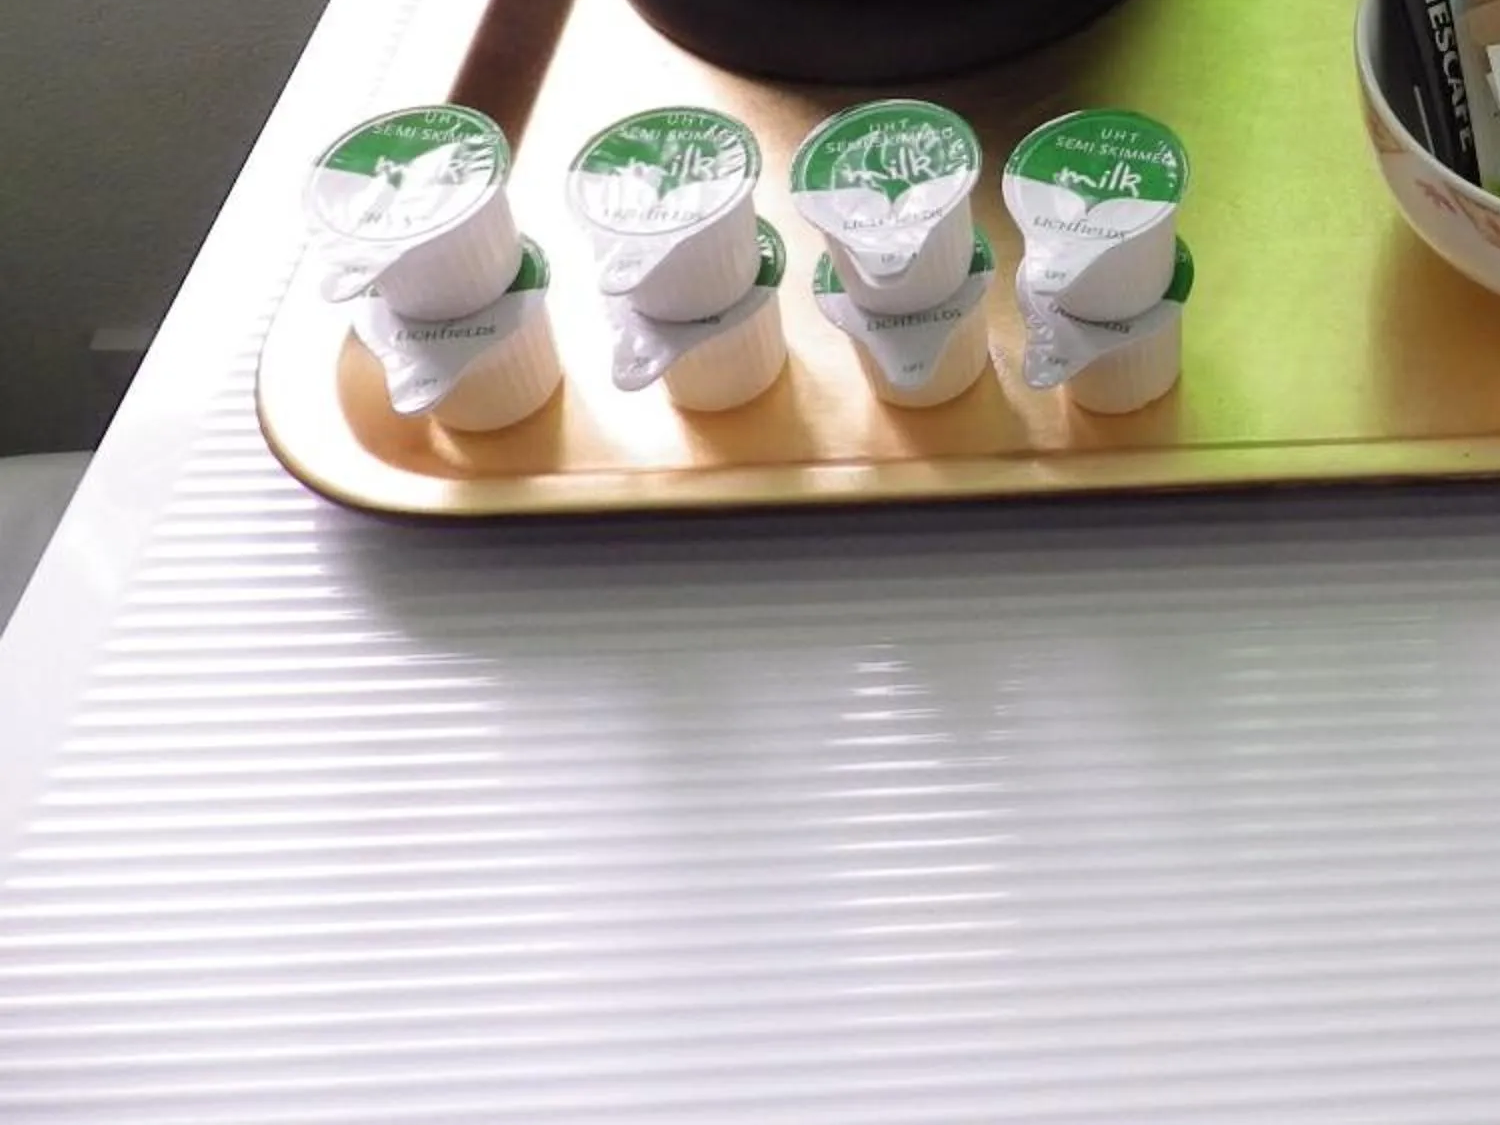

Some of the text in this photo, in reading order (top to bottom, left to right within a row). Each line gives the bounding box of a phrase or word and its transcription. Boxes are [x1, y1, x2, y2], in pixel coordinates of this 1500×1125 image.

[869, 118, 910, 133] UHT
[1055, 135, 1095, 154] SEMI
[1101, 127, 1140, 144] UHT
[838, 146, 938, 183] milk
[1053, 159, 1143, 199] milk
